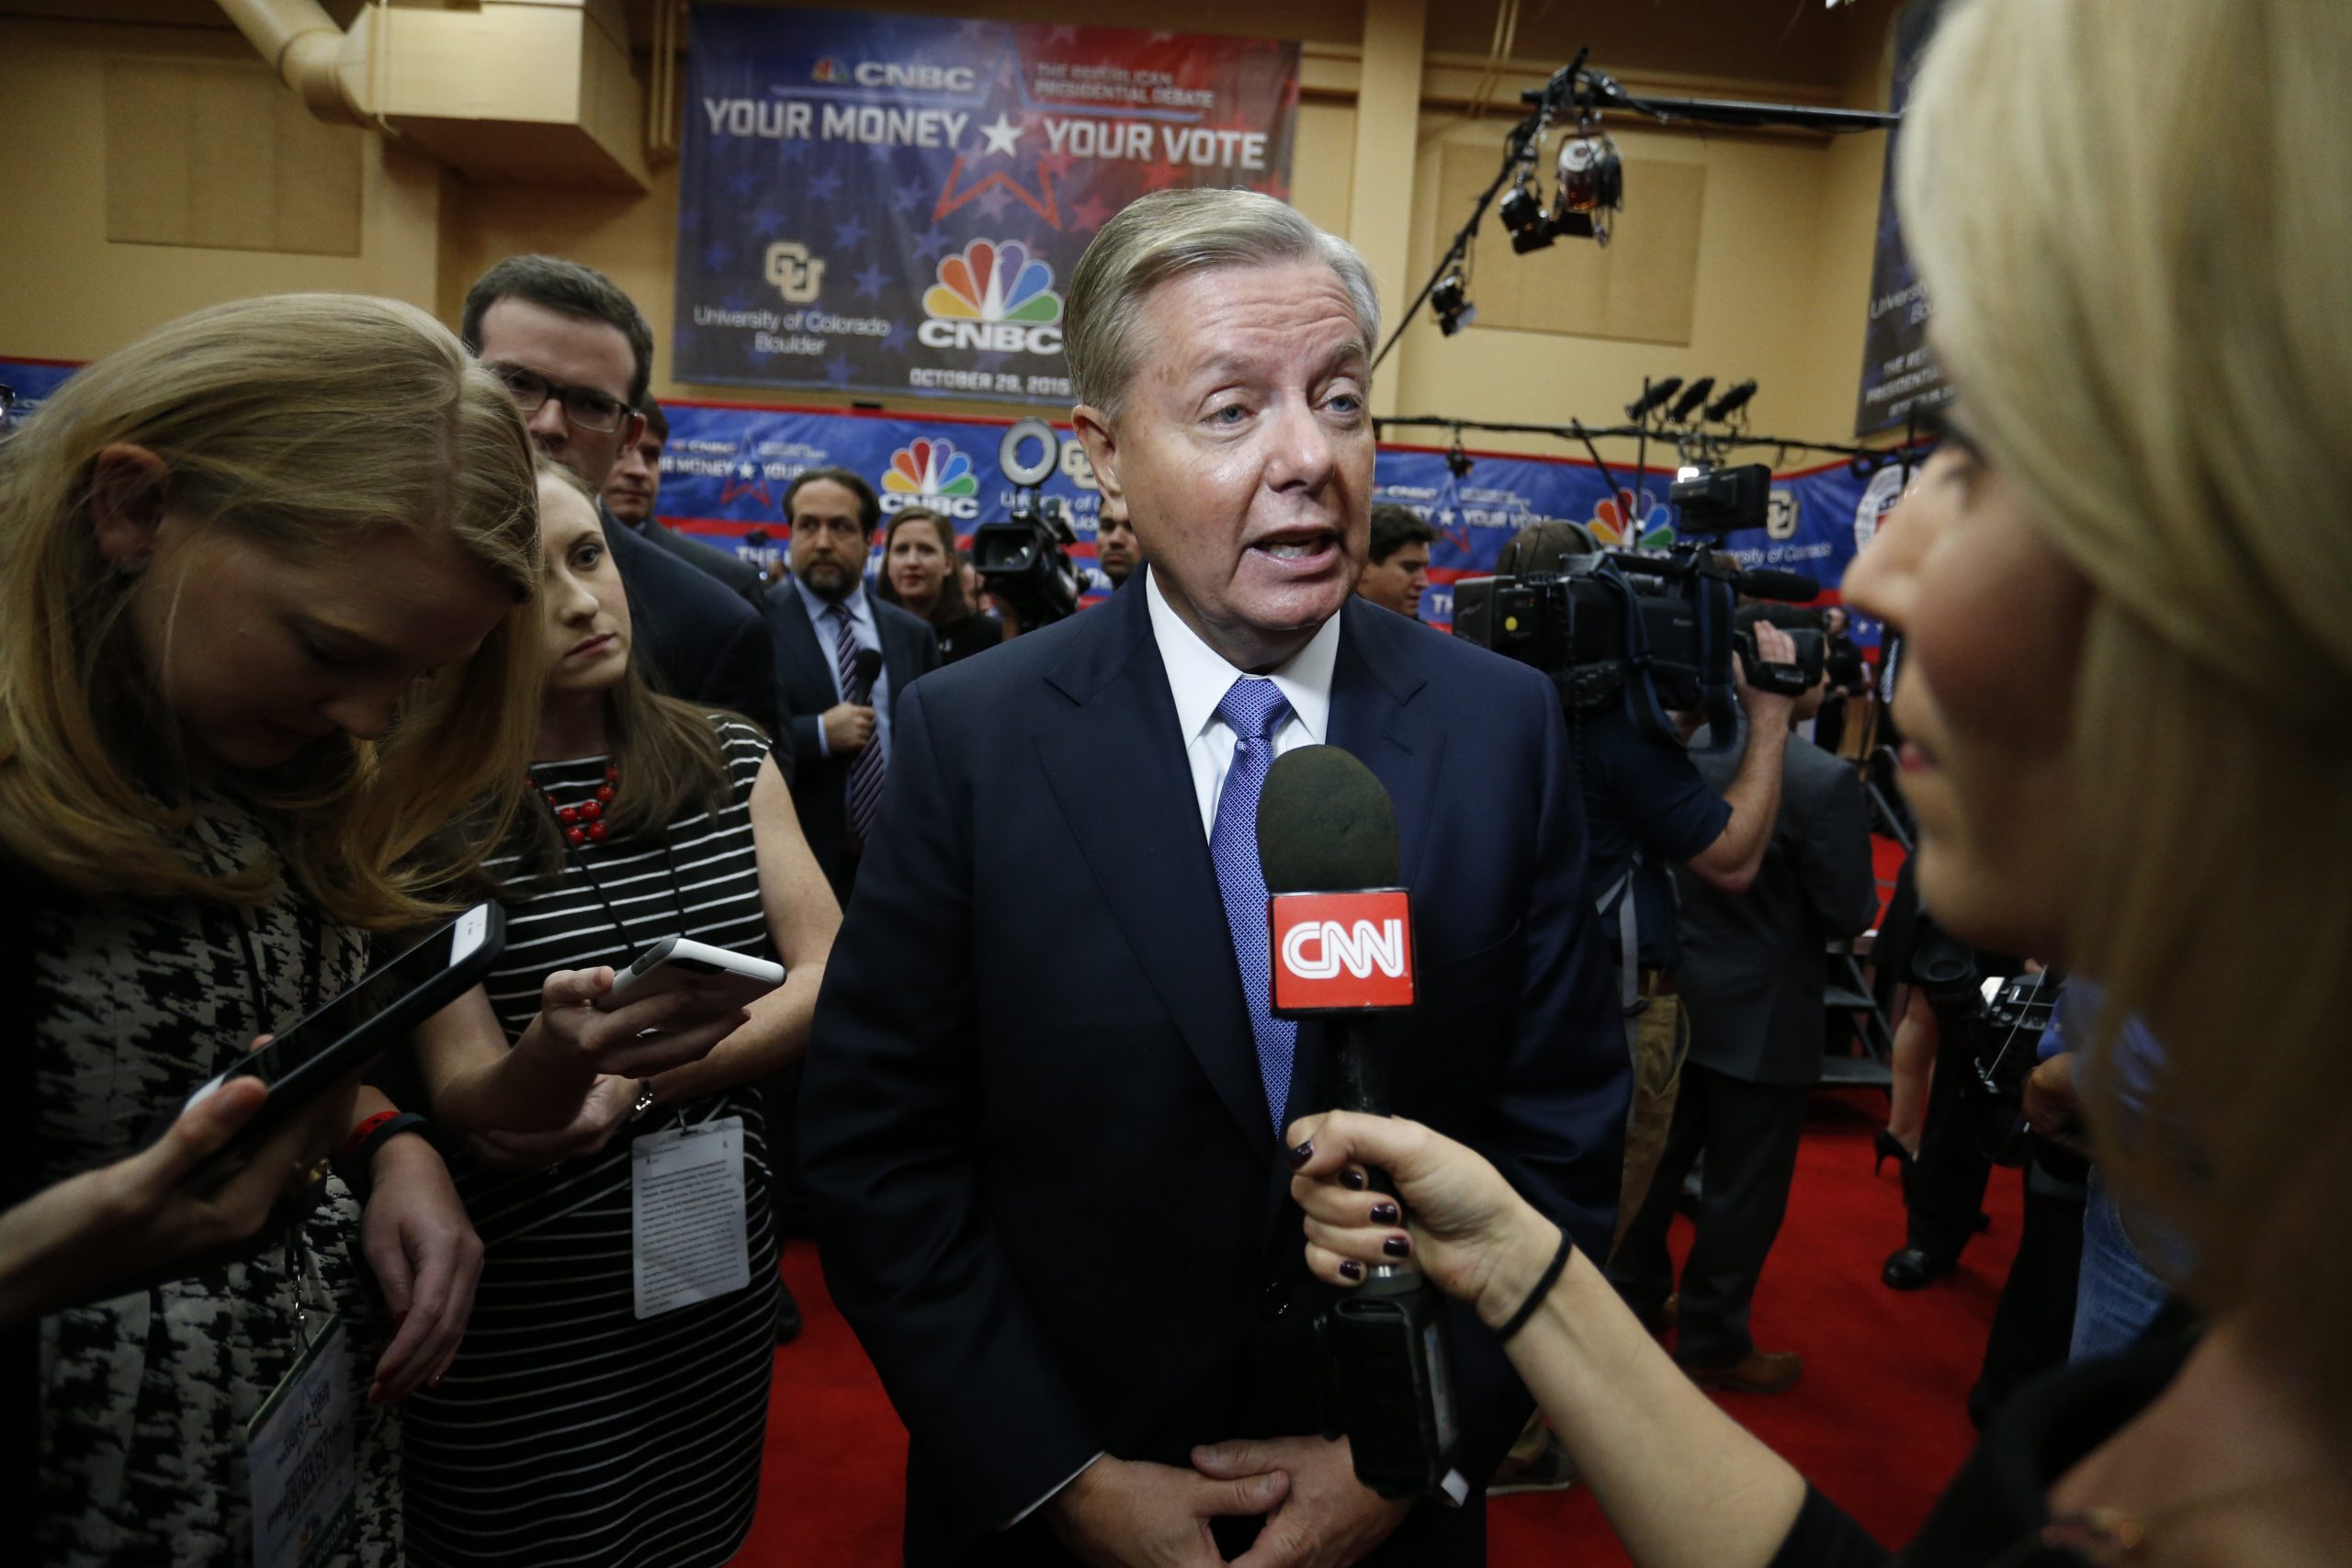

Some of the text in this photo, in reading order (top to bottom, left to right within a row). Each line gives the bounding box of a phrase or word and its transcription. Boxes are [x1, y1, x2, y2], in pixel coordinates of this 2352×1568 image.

[854, 62, 976, 92] CNBC
[1152, 88, 1215, 108] DEBATE
[704, 97, 969, 149] YOUR MONEY
[1044, 118, 1268, 169] YOUR VOTE
[695, 306, 891, 336] University of Colorado
[755, 332, 826, 355] Boulder
[917, 319, 1064, 355] CNBC
[910, 368, 993, 390] OCTOBER
[1027, 376, 1073, 397] 2015
[676, 457, 735, 476] MONEY
[1463, 509, 1507, 528] YOUR
[1282, 919, 1404, 979] CNN
